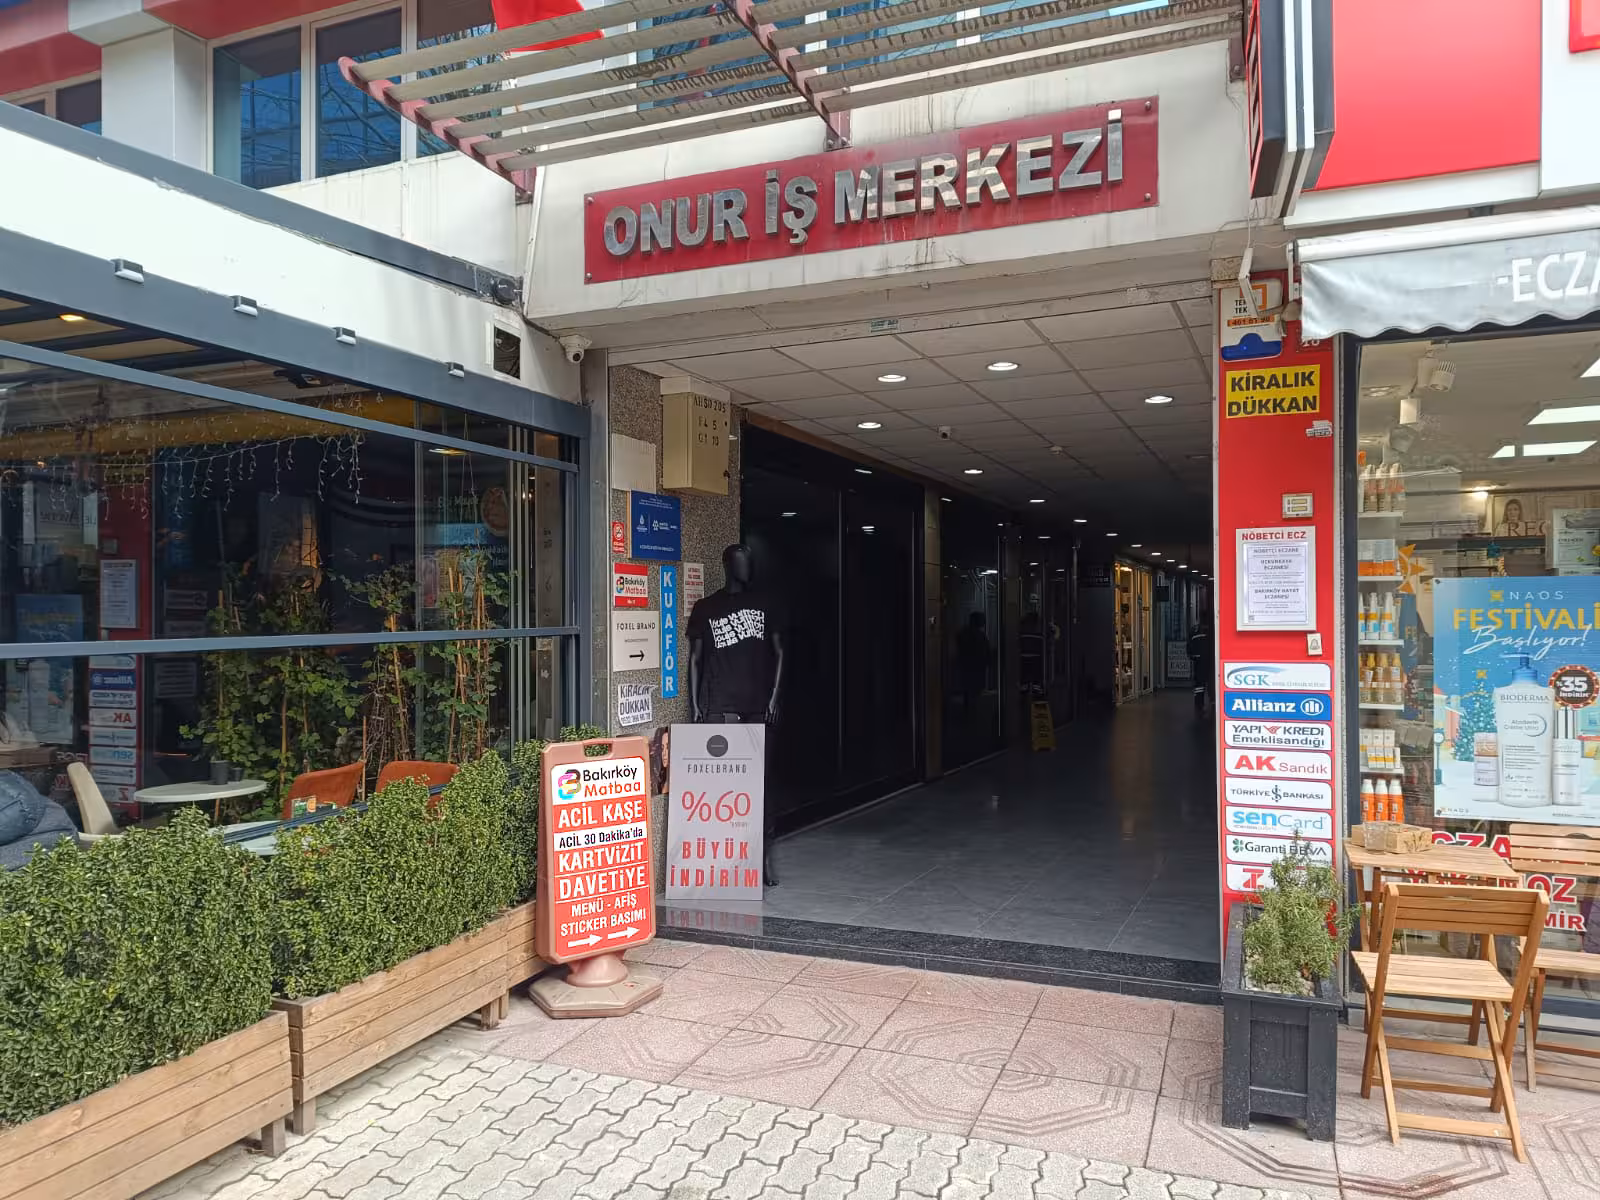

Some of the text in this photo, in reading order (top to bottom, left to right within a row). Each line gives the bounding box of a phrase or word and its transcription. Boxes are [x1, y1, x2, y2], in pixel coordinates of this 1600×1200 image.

[603, 109, 1124, 257] ONUR İŞ MERKEZİ
[1230, 370, 1316, 393] KİRALIK
[1227, 395, 1318, 417] DÜKKAN
[1287, 531, 1307, 539] ECZ
[1509, 590, 1564, 600] NAOS
[616, 622, 656, 630] FOXEL BRAND
[1453, 602, 1600, 630] FESTİVALİ
[663, 571, 676, 692] KUAFÖR
[1463, 623, 1592, 661] Başlıyor!
[1233, 674, 1270, 686] SGK
[1557, 676, 1588, 692] %35
[620, 698, 650, 716] DÜKKAN
[1231, 698, 1297, 713] Allianz
[1231, 724, 1261, 734] YAPI
[1232, 734, 1325, 748] Emeklisandığı
[582, 765, 638, 783] Bakırköy
[687, 763, 748, 774] FOXELBRAND
[1234, 754, 1328, 774] AK Sandık
[584, 781, 641, 798] Matbaa
[1231, 787, 1271, 797] TÜRKİYE
[1283, 791, 1324, 800] BANKASI
[558, 800, 643, 829] ACİL KAŞE
[681, 790, 751, 823] %60
[1233, 810, 1324, 830] senCard
[559, 826, 644, 849] ACİL 30 Dakika'da
[559, 841, 644, 873] KARTVİZİT
[682, 837, 749, 860] BÜYÜK
[1244, 841, 1287, 855] Garanti
[559, 865, 646, 900] DAVETİYE
[670, 864, 759, 888] İNDİRİM
[570, 897, 604, 918] MENÜ
[614, 891, 638, 911] AFİŞ
[560, 907, 647, 937] STICKER BASIMI
